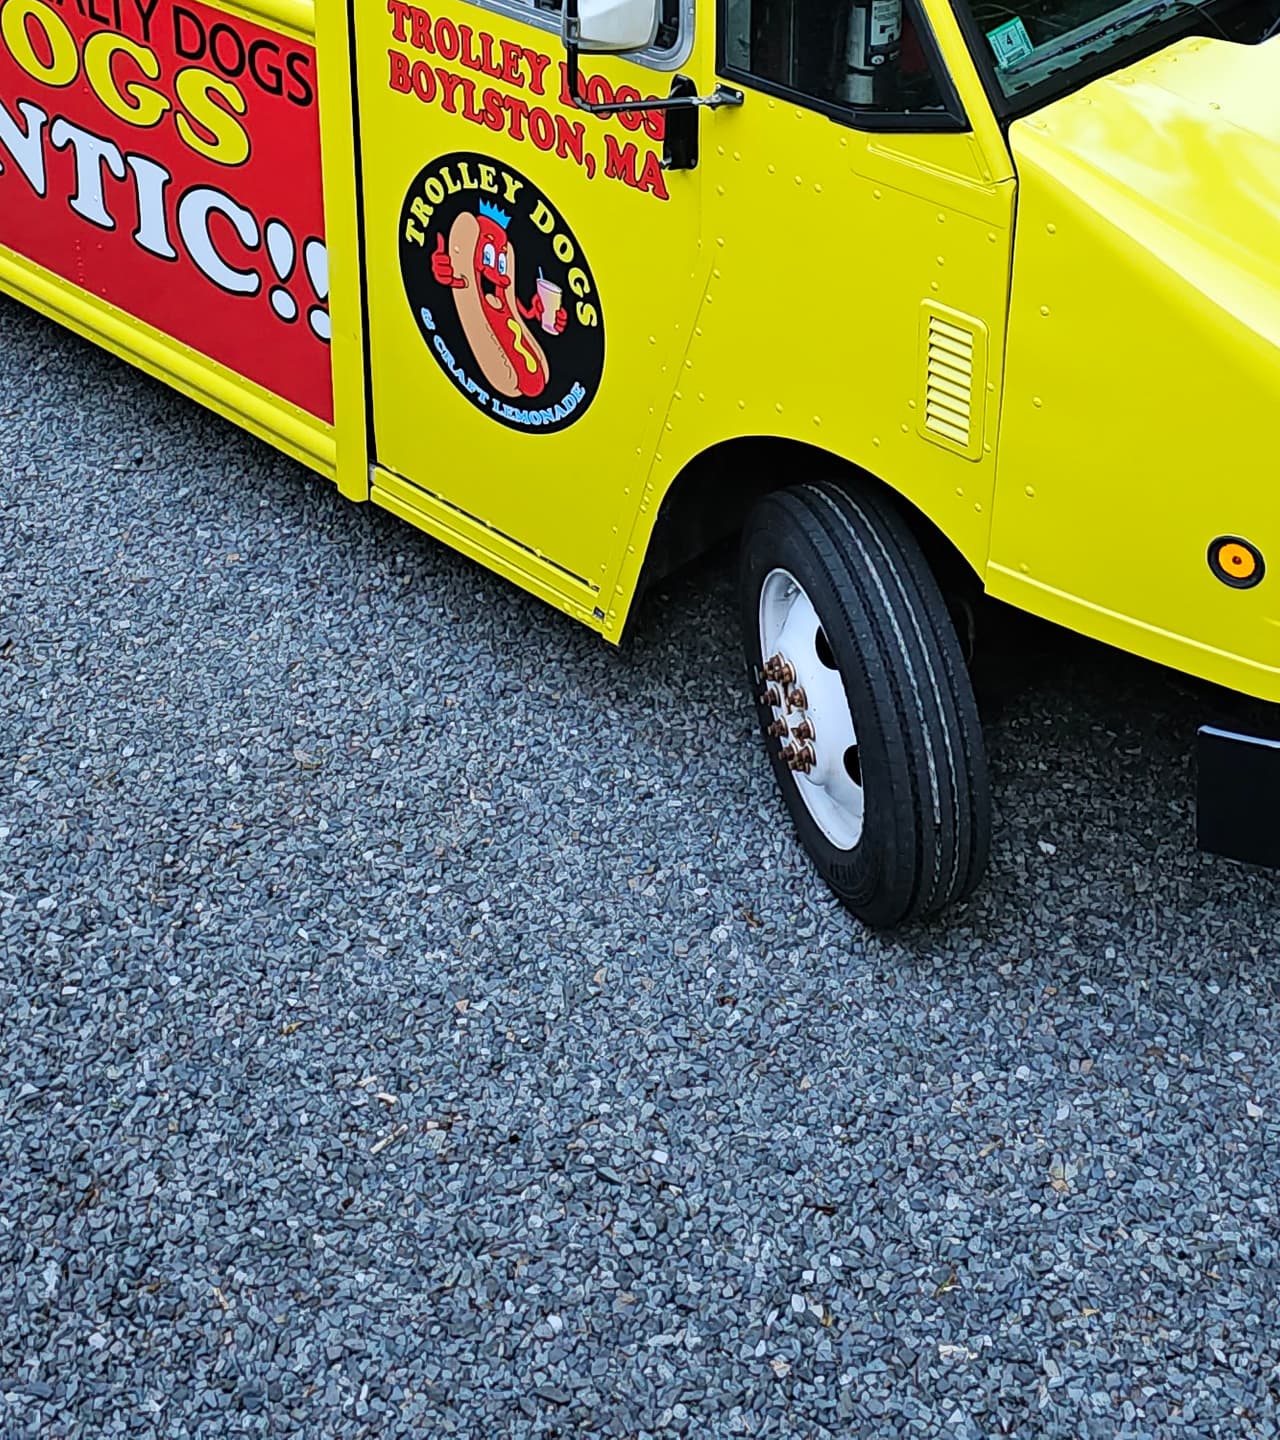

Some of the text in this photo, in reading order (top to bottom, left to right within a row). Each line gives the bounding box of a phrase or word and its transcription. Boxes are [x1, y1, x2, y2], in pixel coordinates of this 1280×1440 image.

[174, 5, 314, 108] DOGS
[387, 49, 670, 201] BOYLSTON, MA
[405, 162, 598, 328] TROLLEY DOGS
[420, 307, 586, 426] & CRAFT LEMONADE
